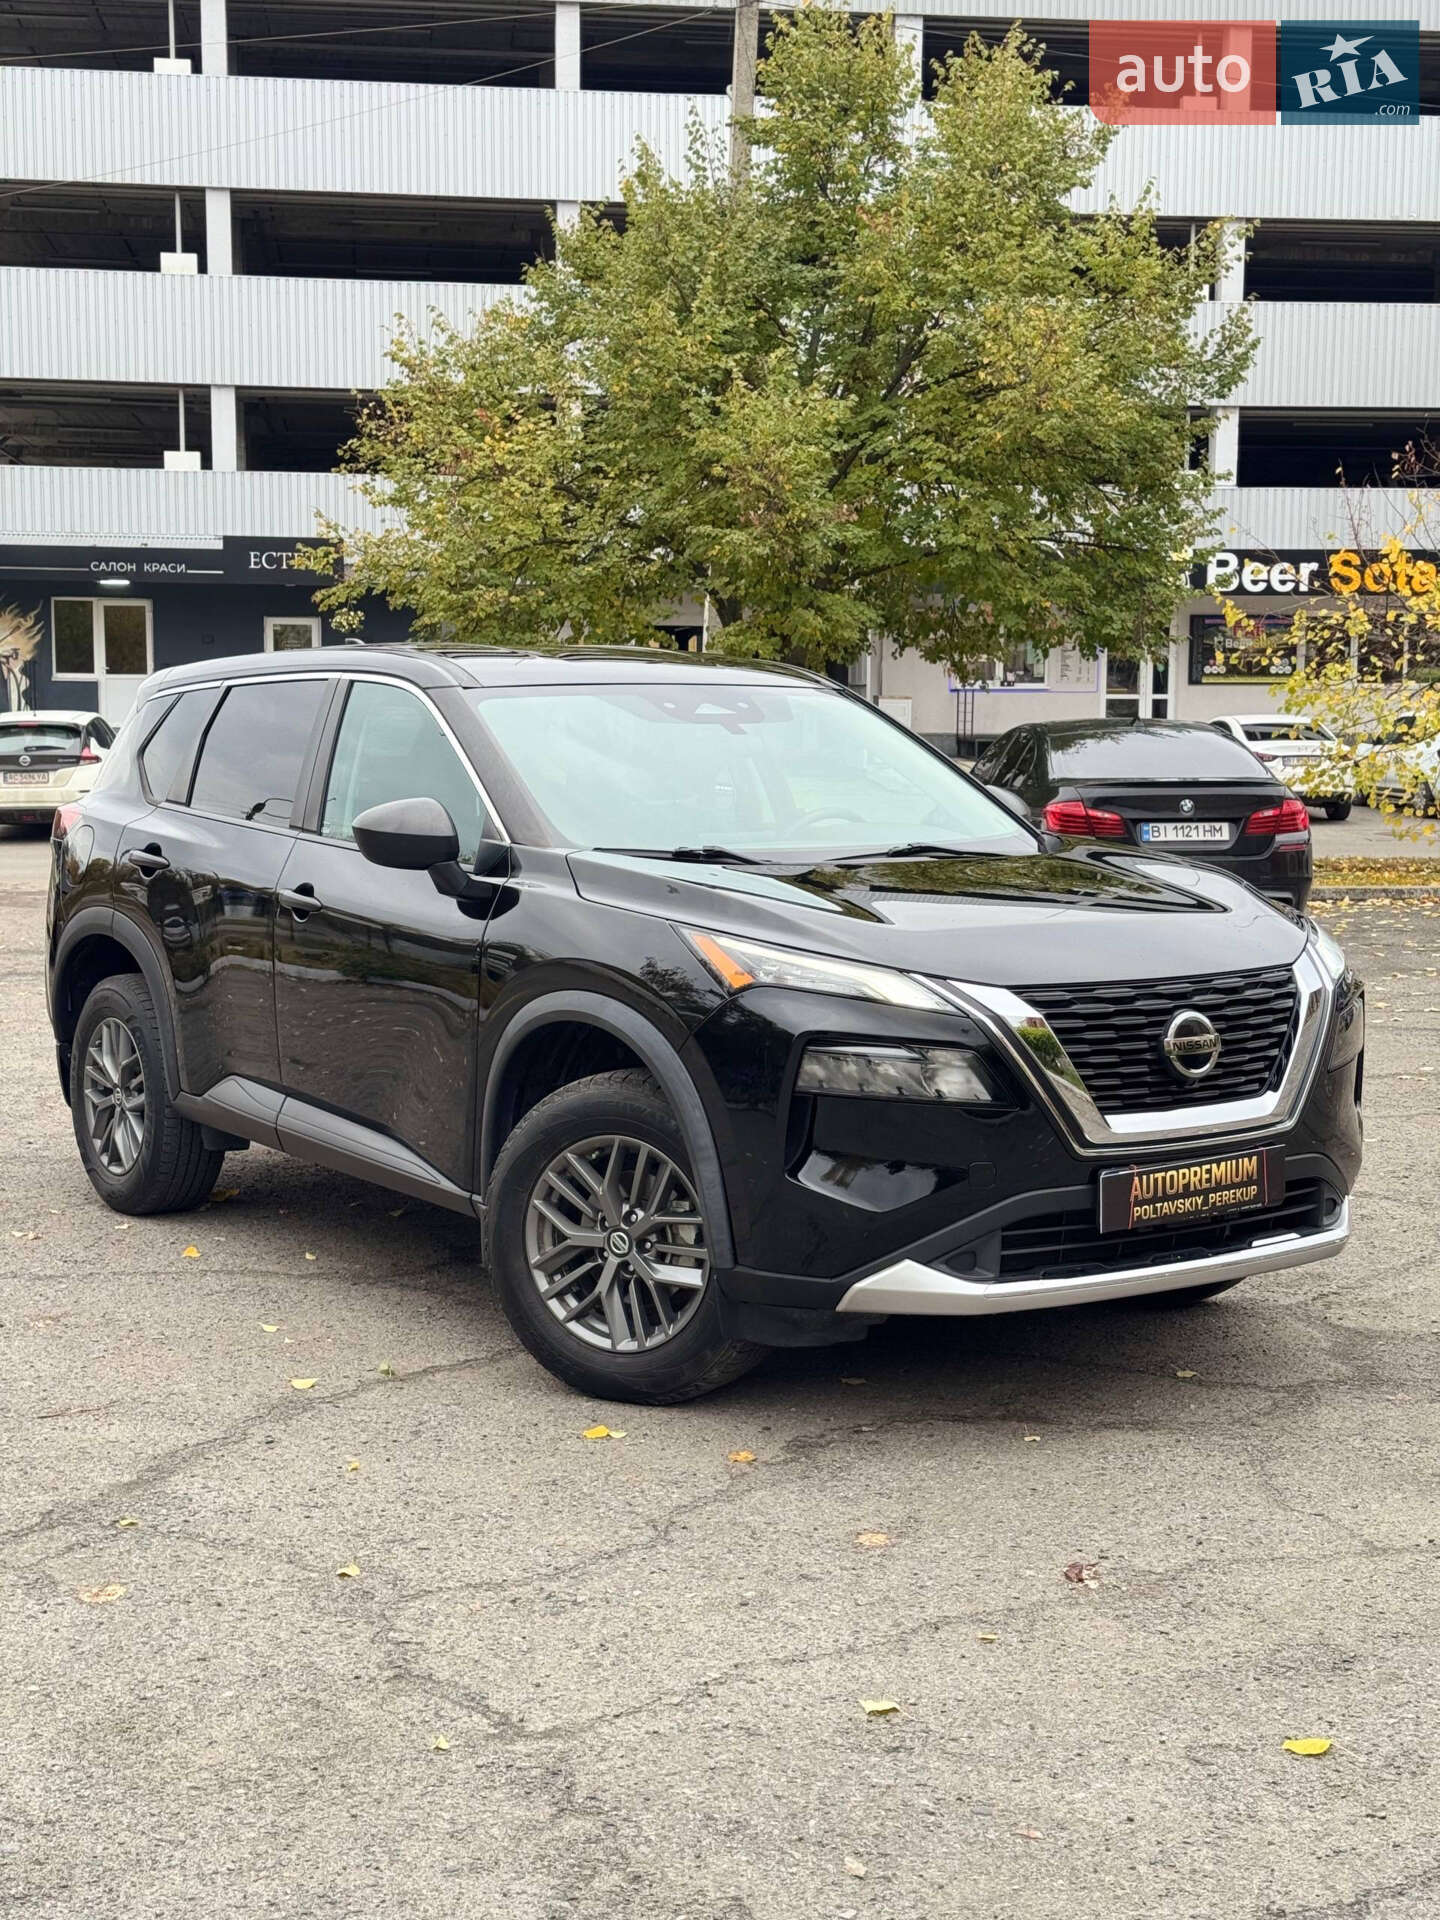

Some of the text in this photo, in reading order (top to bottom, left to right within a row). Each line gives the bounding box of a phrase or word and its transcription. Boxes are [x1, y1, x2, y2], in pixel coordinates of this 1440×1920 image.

[90, 561, 186, 573] САЛОН КРАСИ
[1206, 552, 1319, 593] Beer
[1151, 824, 1223, 838] BI 1121 HM
[1172, 1035, 1218, 1052] NISSAN
[1130, 1155, 1258, 1201] AUTOPREMIUM
[1133, 1185, 1258, 1221] POLTAVSKIY_PEREKUP
